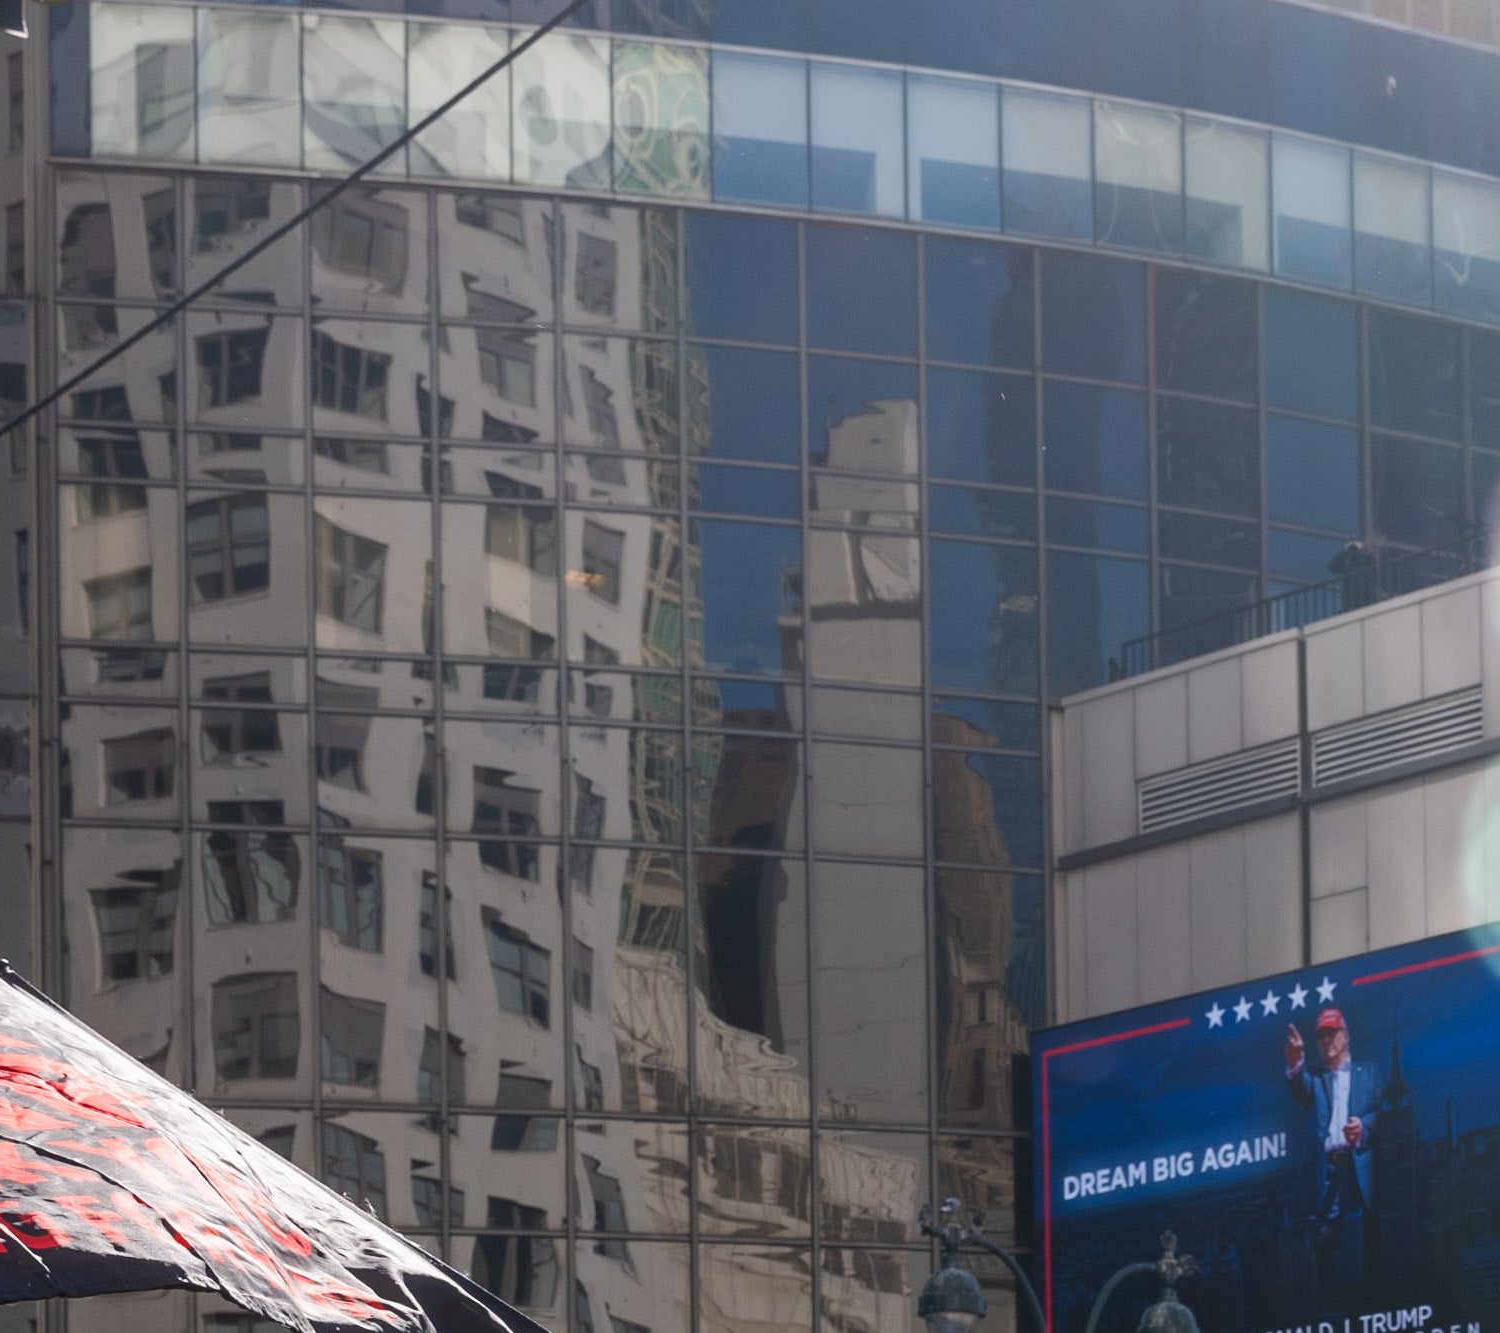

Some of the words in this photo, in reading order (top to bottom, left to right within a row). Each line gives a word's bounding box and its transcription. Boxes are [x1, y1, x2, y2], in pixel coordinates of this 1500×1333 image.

[1062, 1160, 1149, 1200] DREAM
[1153, 1151, 1195, 1183] BIG
[1200, 1132, 1288, 1174] AGAIN!
